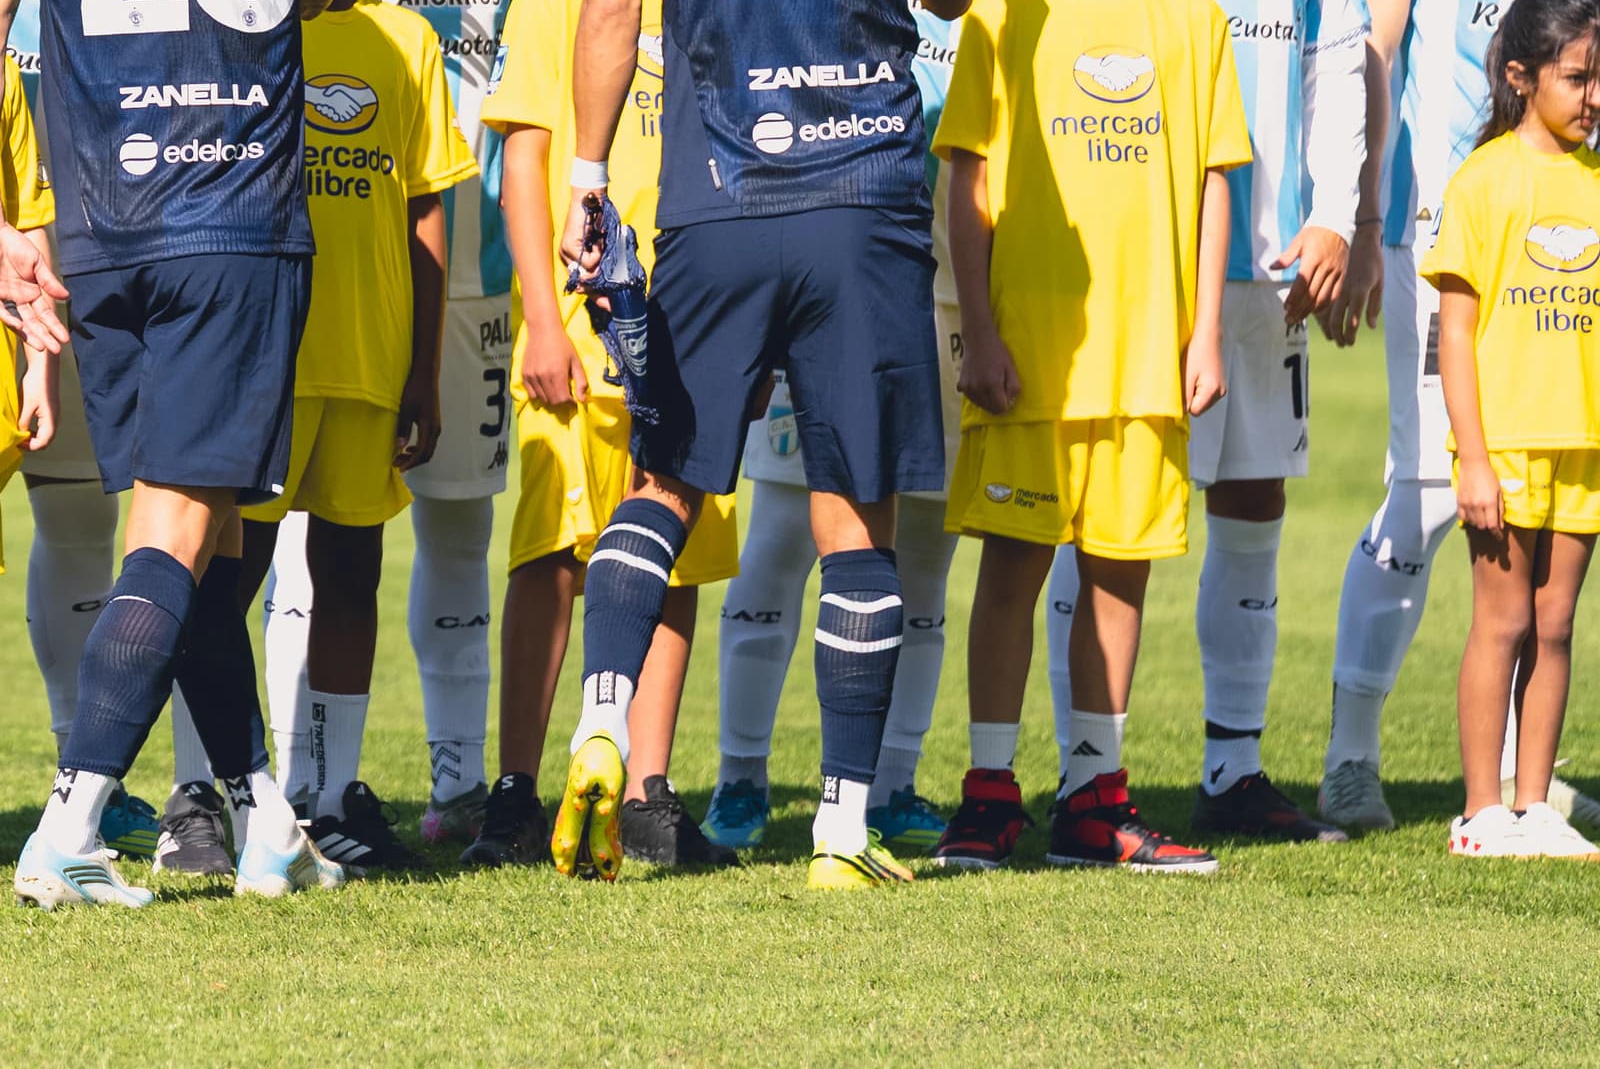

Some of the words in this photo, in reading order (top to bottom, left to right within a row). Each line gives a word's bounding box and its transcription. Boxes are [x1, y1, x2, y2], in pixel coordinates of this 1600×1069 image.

[748, 60, 894, 91] ZANELLA
[119, 82, 270, 110] ZANELLA
[798, 114, 905, 142] edelcos
[1051, 110, 1168, 137] mercad
[163, 137, 265, 165] edelcos
[304, 144, 395, 176] ercado
[1087, 137, 1149, 165] libre
[305, 169, 372, 200] libre
[1502, 284, 1600, 306] merca
[480, 312, 512, 351] PAL
[1536, 307, 1593, 334] libre
[1016, 488, 1058, 504] mercado
